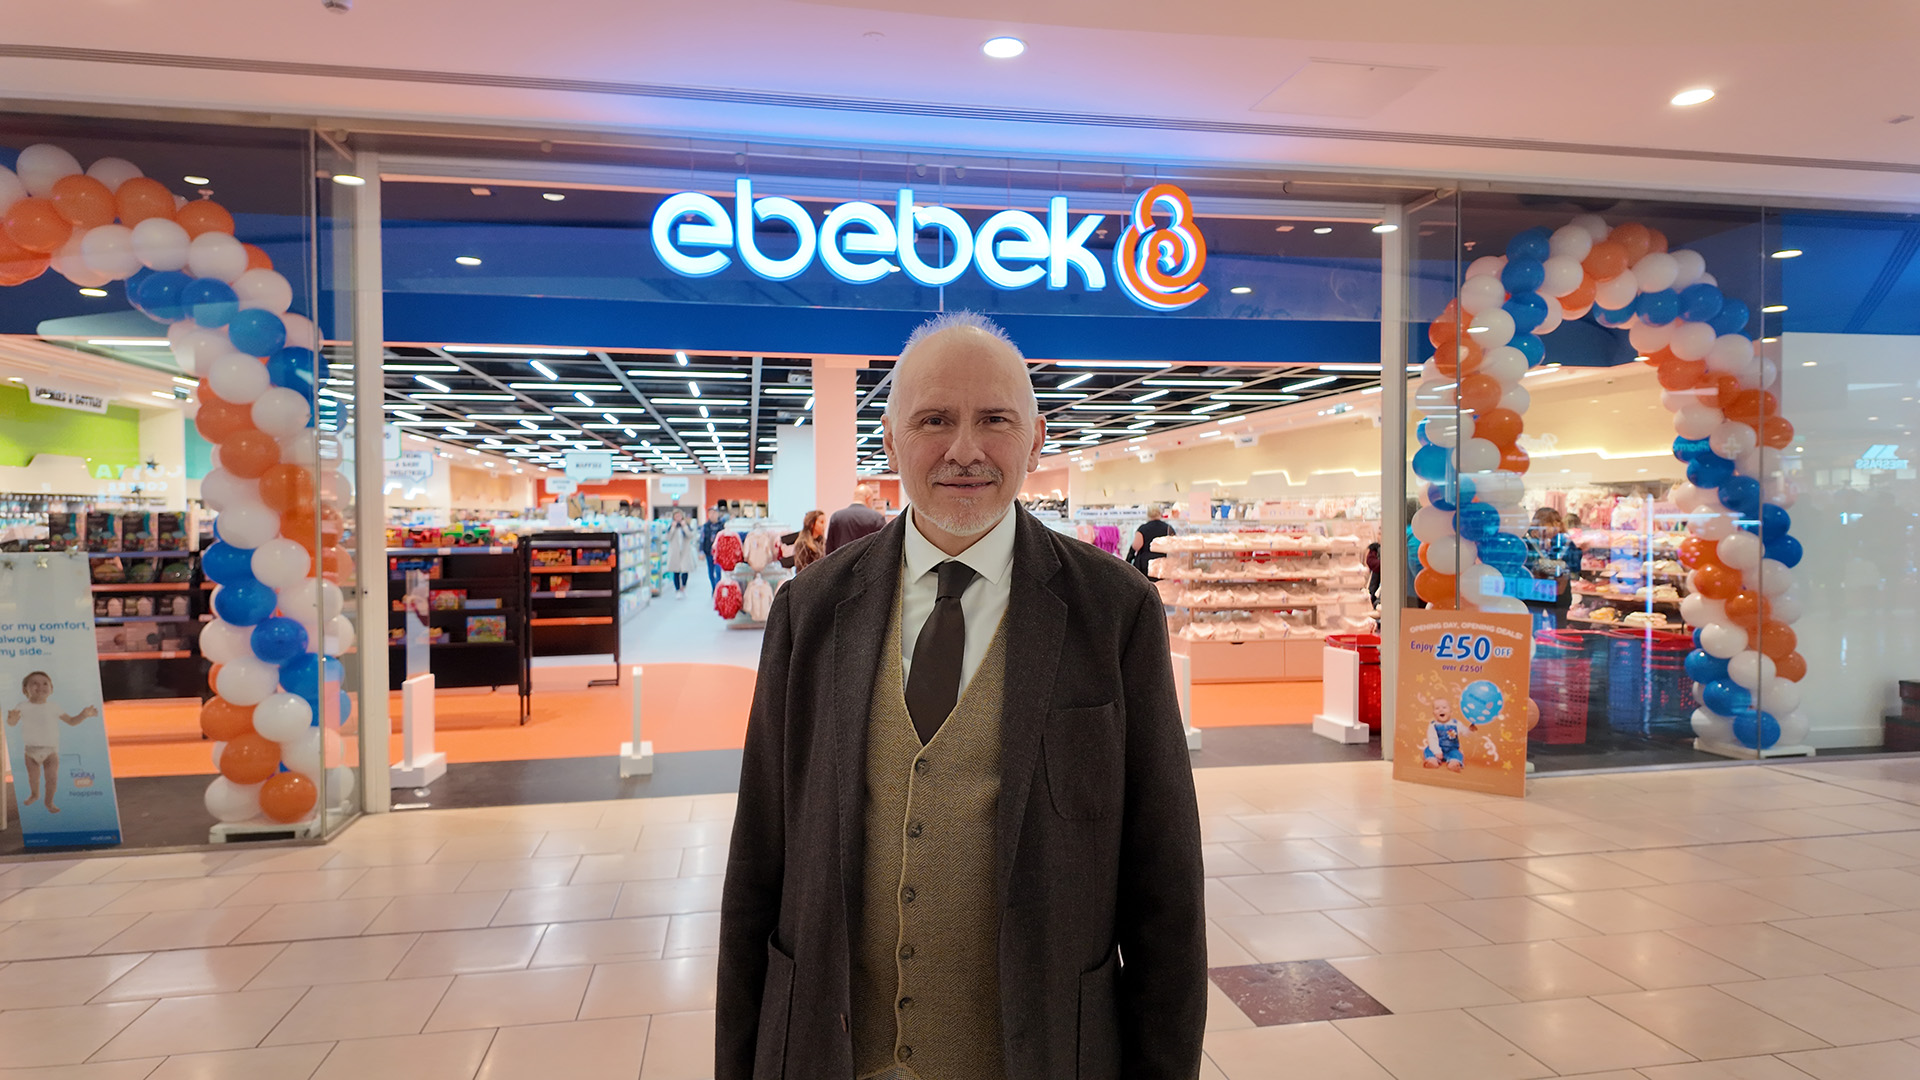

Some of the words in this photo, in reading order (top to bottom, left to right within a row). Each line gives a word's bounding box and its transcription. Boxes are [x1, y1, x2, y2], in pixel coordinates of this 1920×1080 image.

[651, 178, 1107, 293] ebebek
[18, 623, 36, 632] my
[39, 622, 90, 632] comfort,
[1409, 622, 1442, 634] OPENING
[1460, 622, 1495, 633] OPENING
[1495, 627, 1524, 640] DEALS!
[40, 634, 55, 645] by
[1410, 640, 1434, 653] Enjoy
[1436, 634, 1491, 661] £50
[1494, 647, 1513, 658] OFF
[0, 649, 16, 658] my
[1459, 665, 1483, 673] £250!
